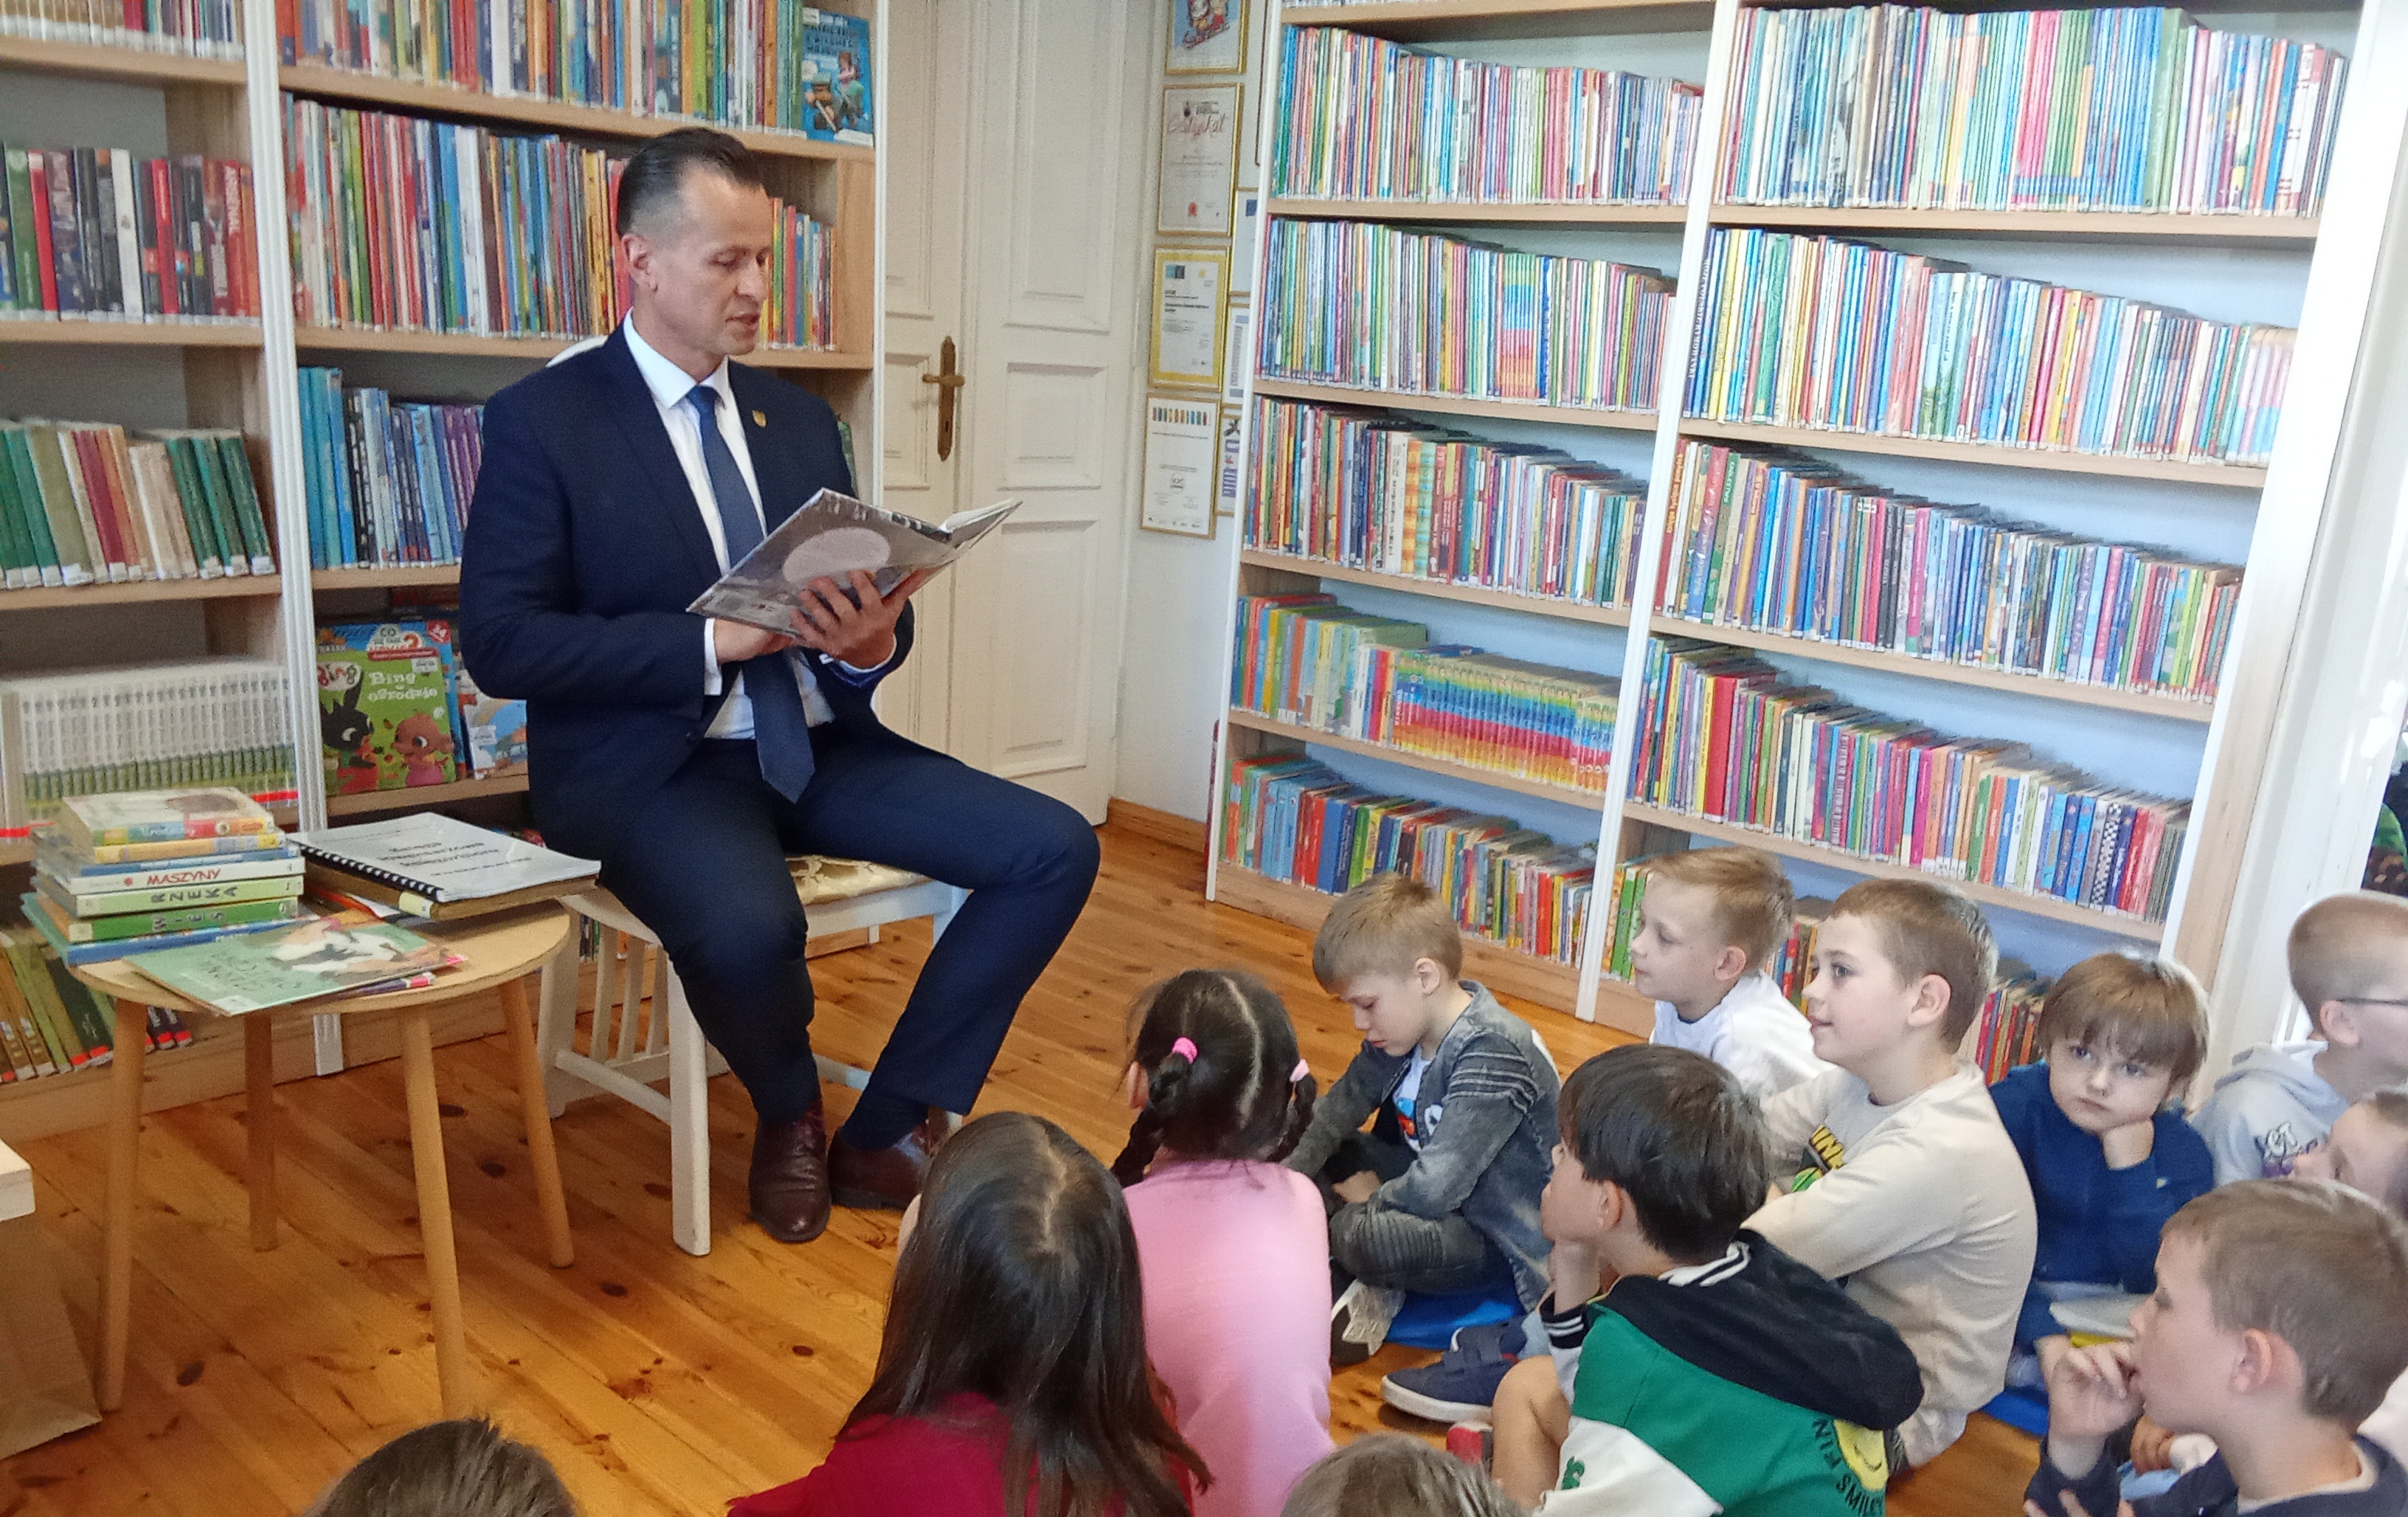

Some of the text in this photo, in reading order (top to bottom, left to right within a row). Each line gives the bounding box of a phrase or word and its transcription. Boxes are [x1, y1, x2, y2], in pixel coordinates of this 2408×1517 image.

[369, 671, 417, 685] Bing
[147, 869, 221, 885] MASZYNY
[150, 885, 238, 903] RZEKA
